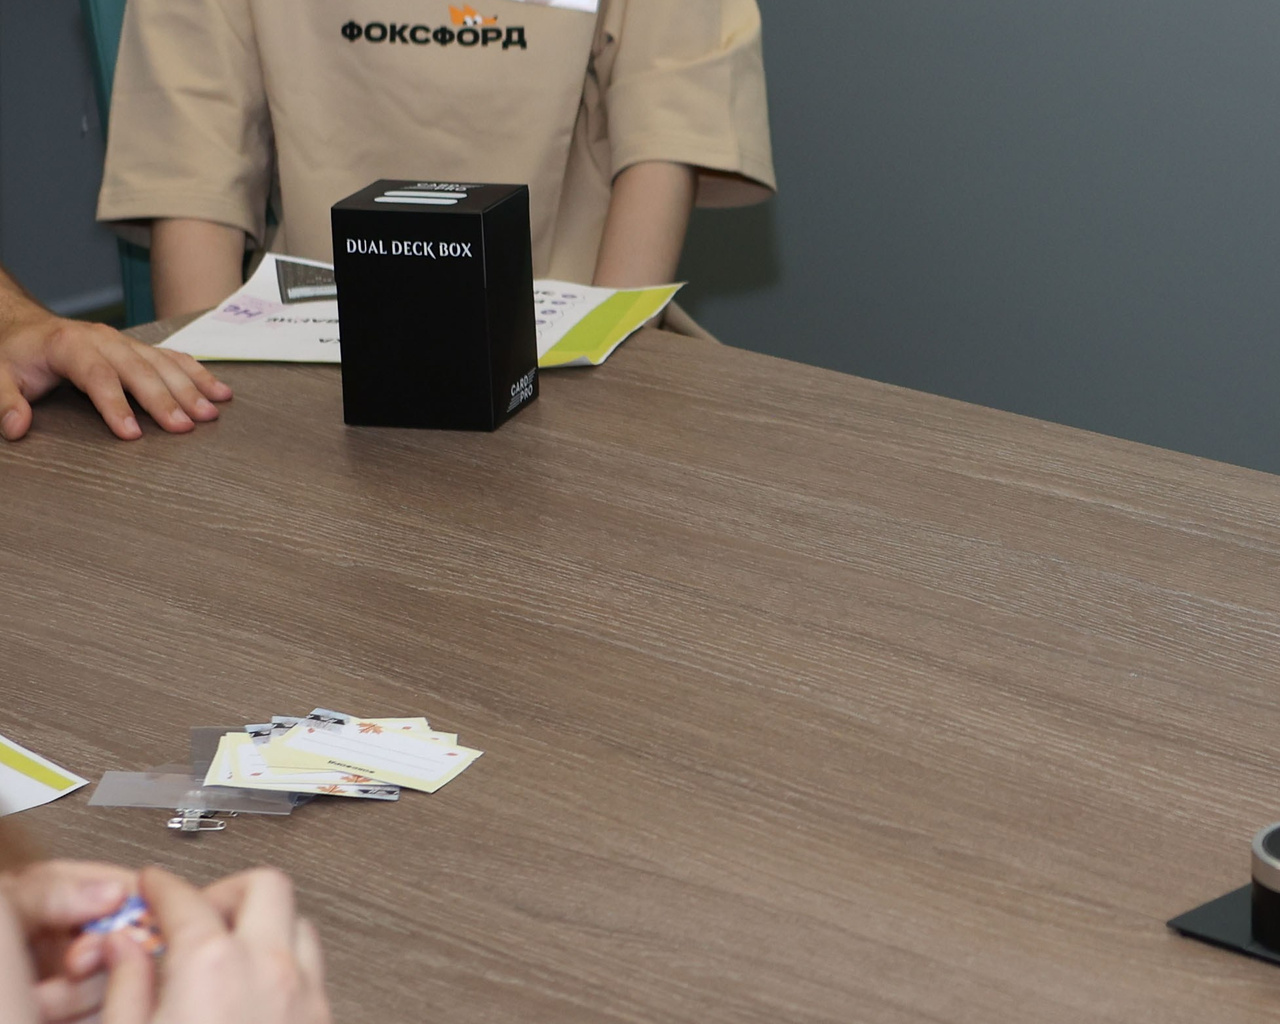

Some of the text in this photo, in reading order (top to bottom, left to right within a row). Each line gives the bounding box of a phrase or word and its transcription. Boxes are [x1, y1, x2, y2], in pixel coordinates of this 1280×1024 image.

[341, 19, 528, 51] ФОКСФОРД
[346, 238, 473, 260] DUAL DECK BOX
[510, 374, 529, 397] CARD
[520, 383, 533, 403] PRO
